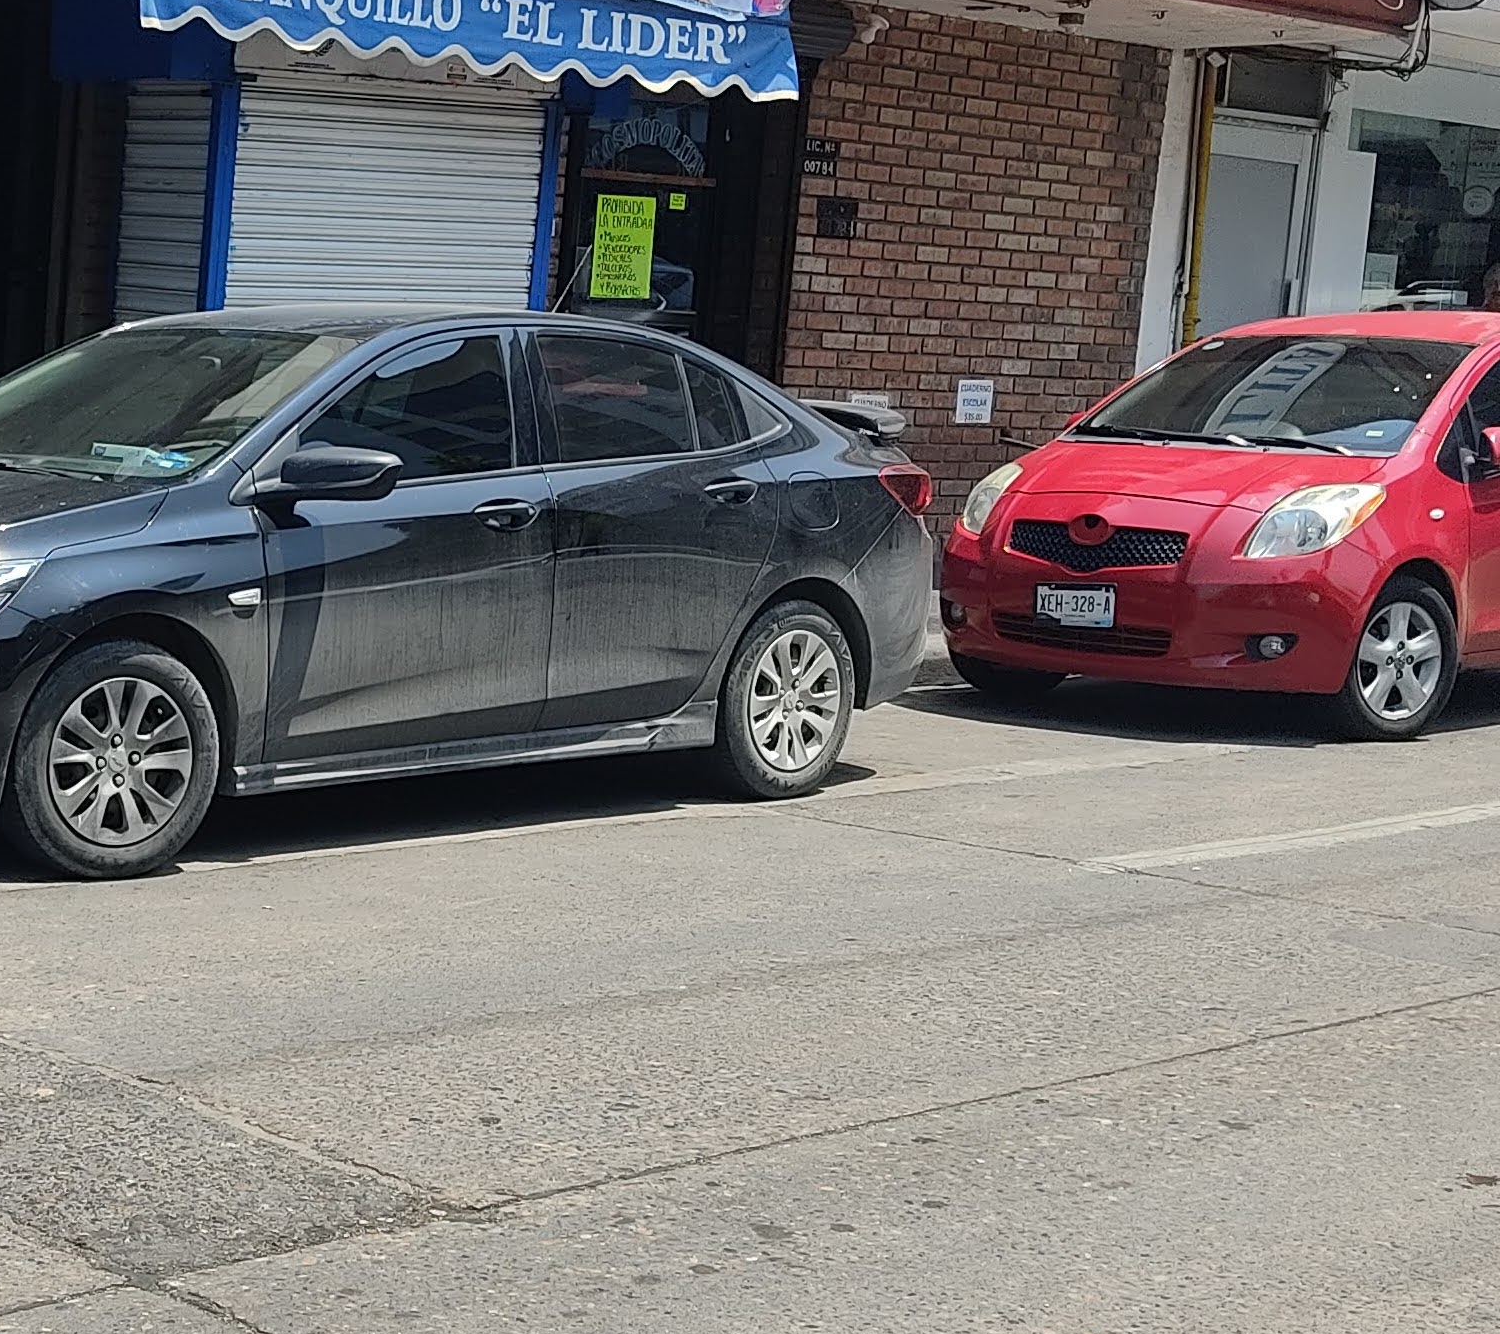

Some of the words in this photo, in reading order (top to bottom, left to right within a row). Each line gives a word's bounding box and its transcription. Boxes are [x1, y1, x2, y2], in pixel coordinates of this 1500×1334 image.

[602, 197, 645, 215] PROHIBIDA
[960, 383, 992, 393] CUADERNO
[962, 398, 988, 407] ESCOLAR
[1039, 593, 1111, 615] XEH-328-A
